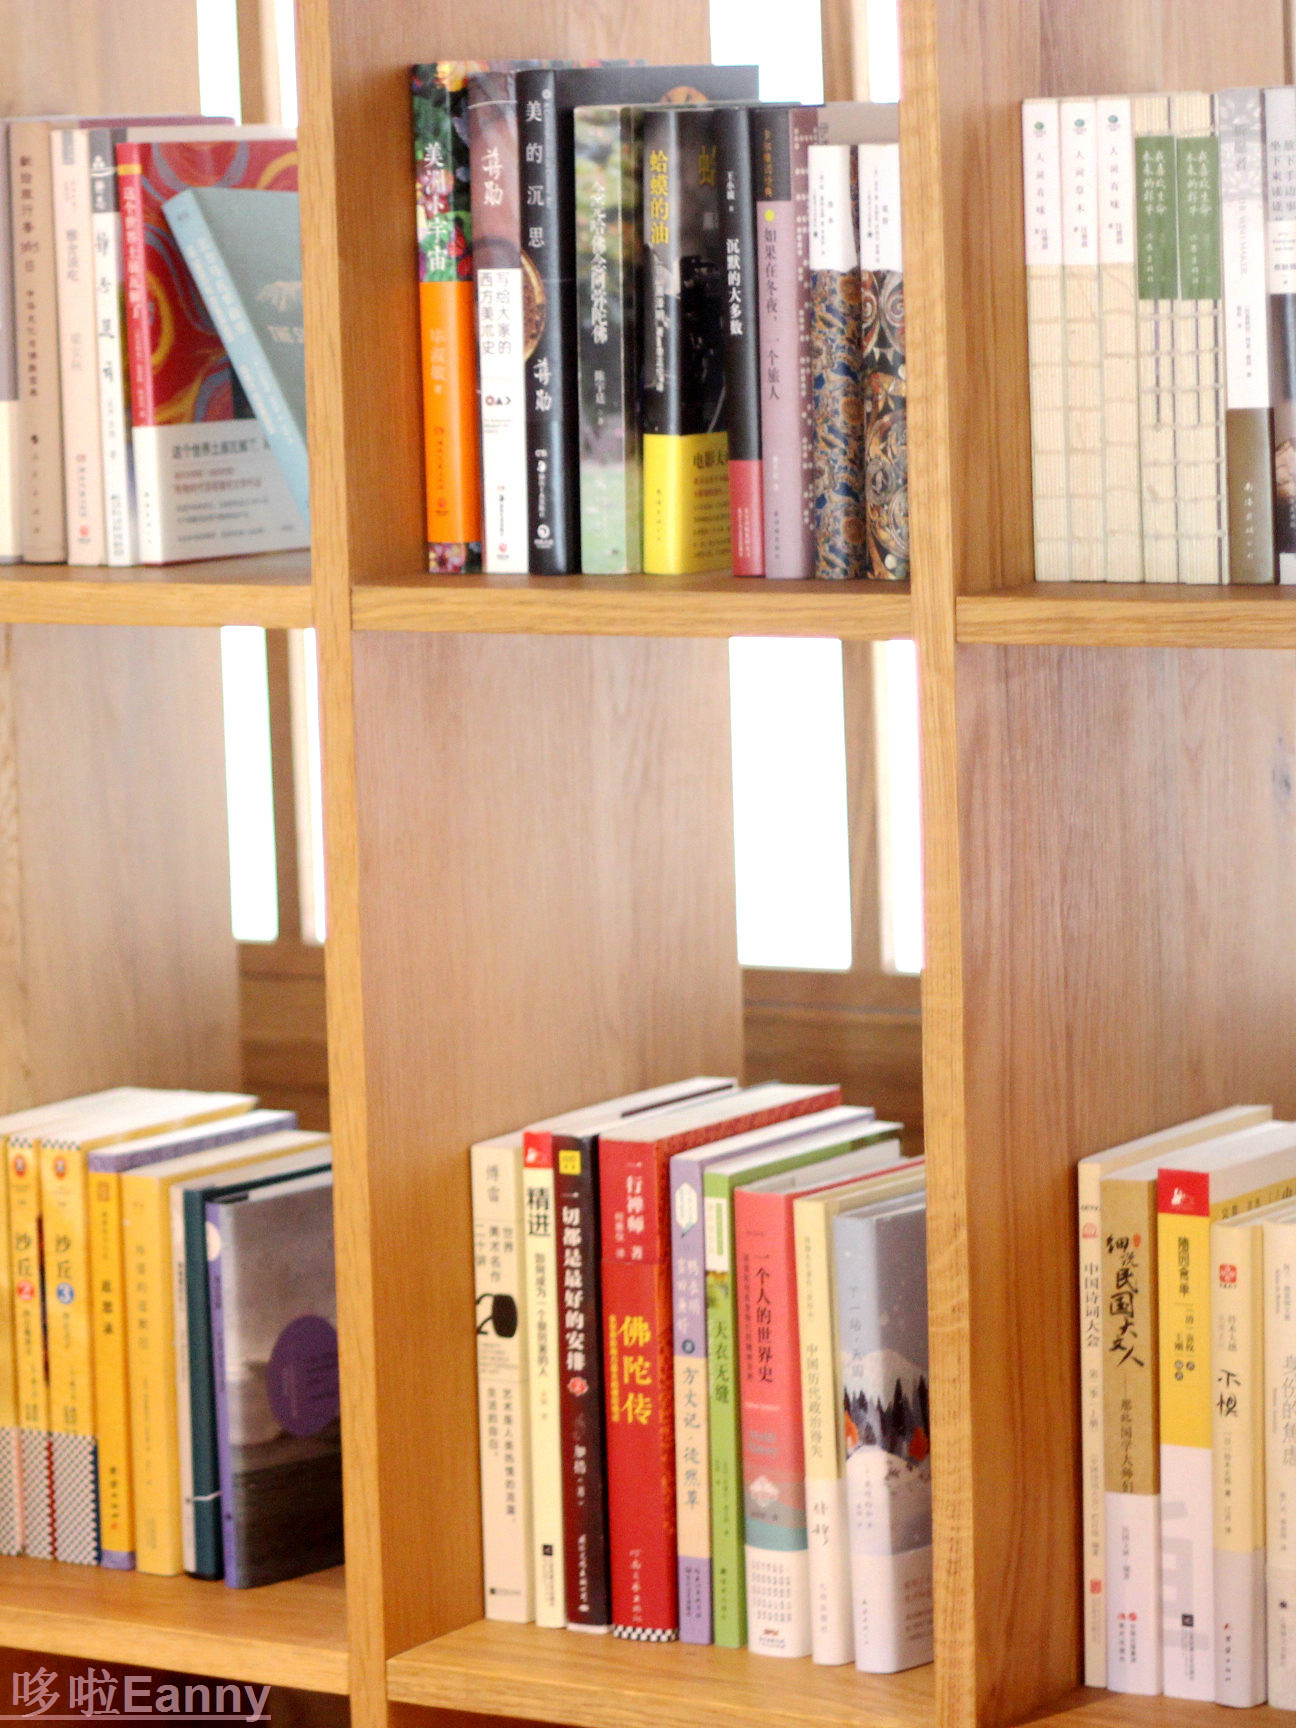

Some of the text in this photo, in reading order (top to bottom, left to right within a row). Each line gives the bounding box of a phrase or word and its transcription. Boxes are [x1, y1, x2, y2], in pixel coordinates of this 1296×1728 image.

[525, 100, 546, 248] 美的沉思
[649, 149, 670, 245] 蛤蟆的油
[726, 238, 743, 336] 沉默的大多数
[15, 1232, 32, 1278] 沙丘
[56, 1234, 72, 1280] 沙丘
[526, 1187, 551, 1237] 精进
[561, 1190, 586, 1372] 一切都是最好的安排
[756, 1254, 773, 1384] 一个人的世界史
[1084, 1262, 1100, 1348] 中国诗词大会
[1105, 1234, 1144, 1367] 细说民国大文人
[618, 1315, 652, 1426] 佛陀传
[715, 1321, 730, 1403] 天衣无缝
[806, 1343, 824, 1458] 中国历代政治得失
